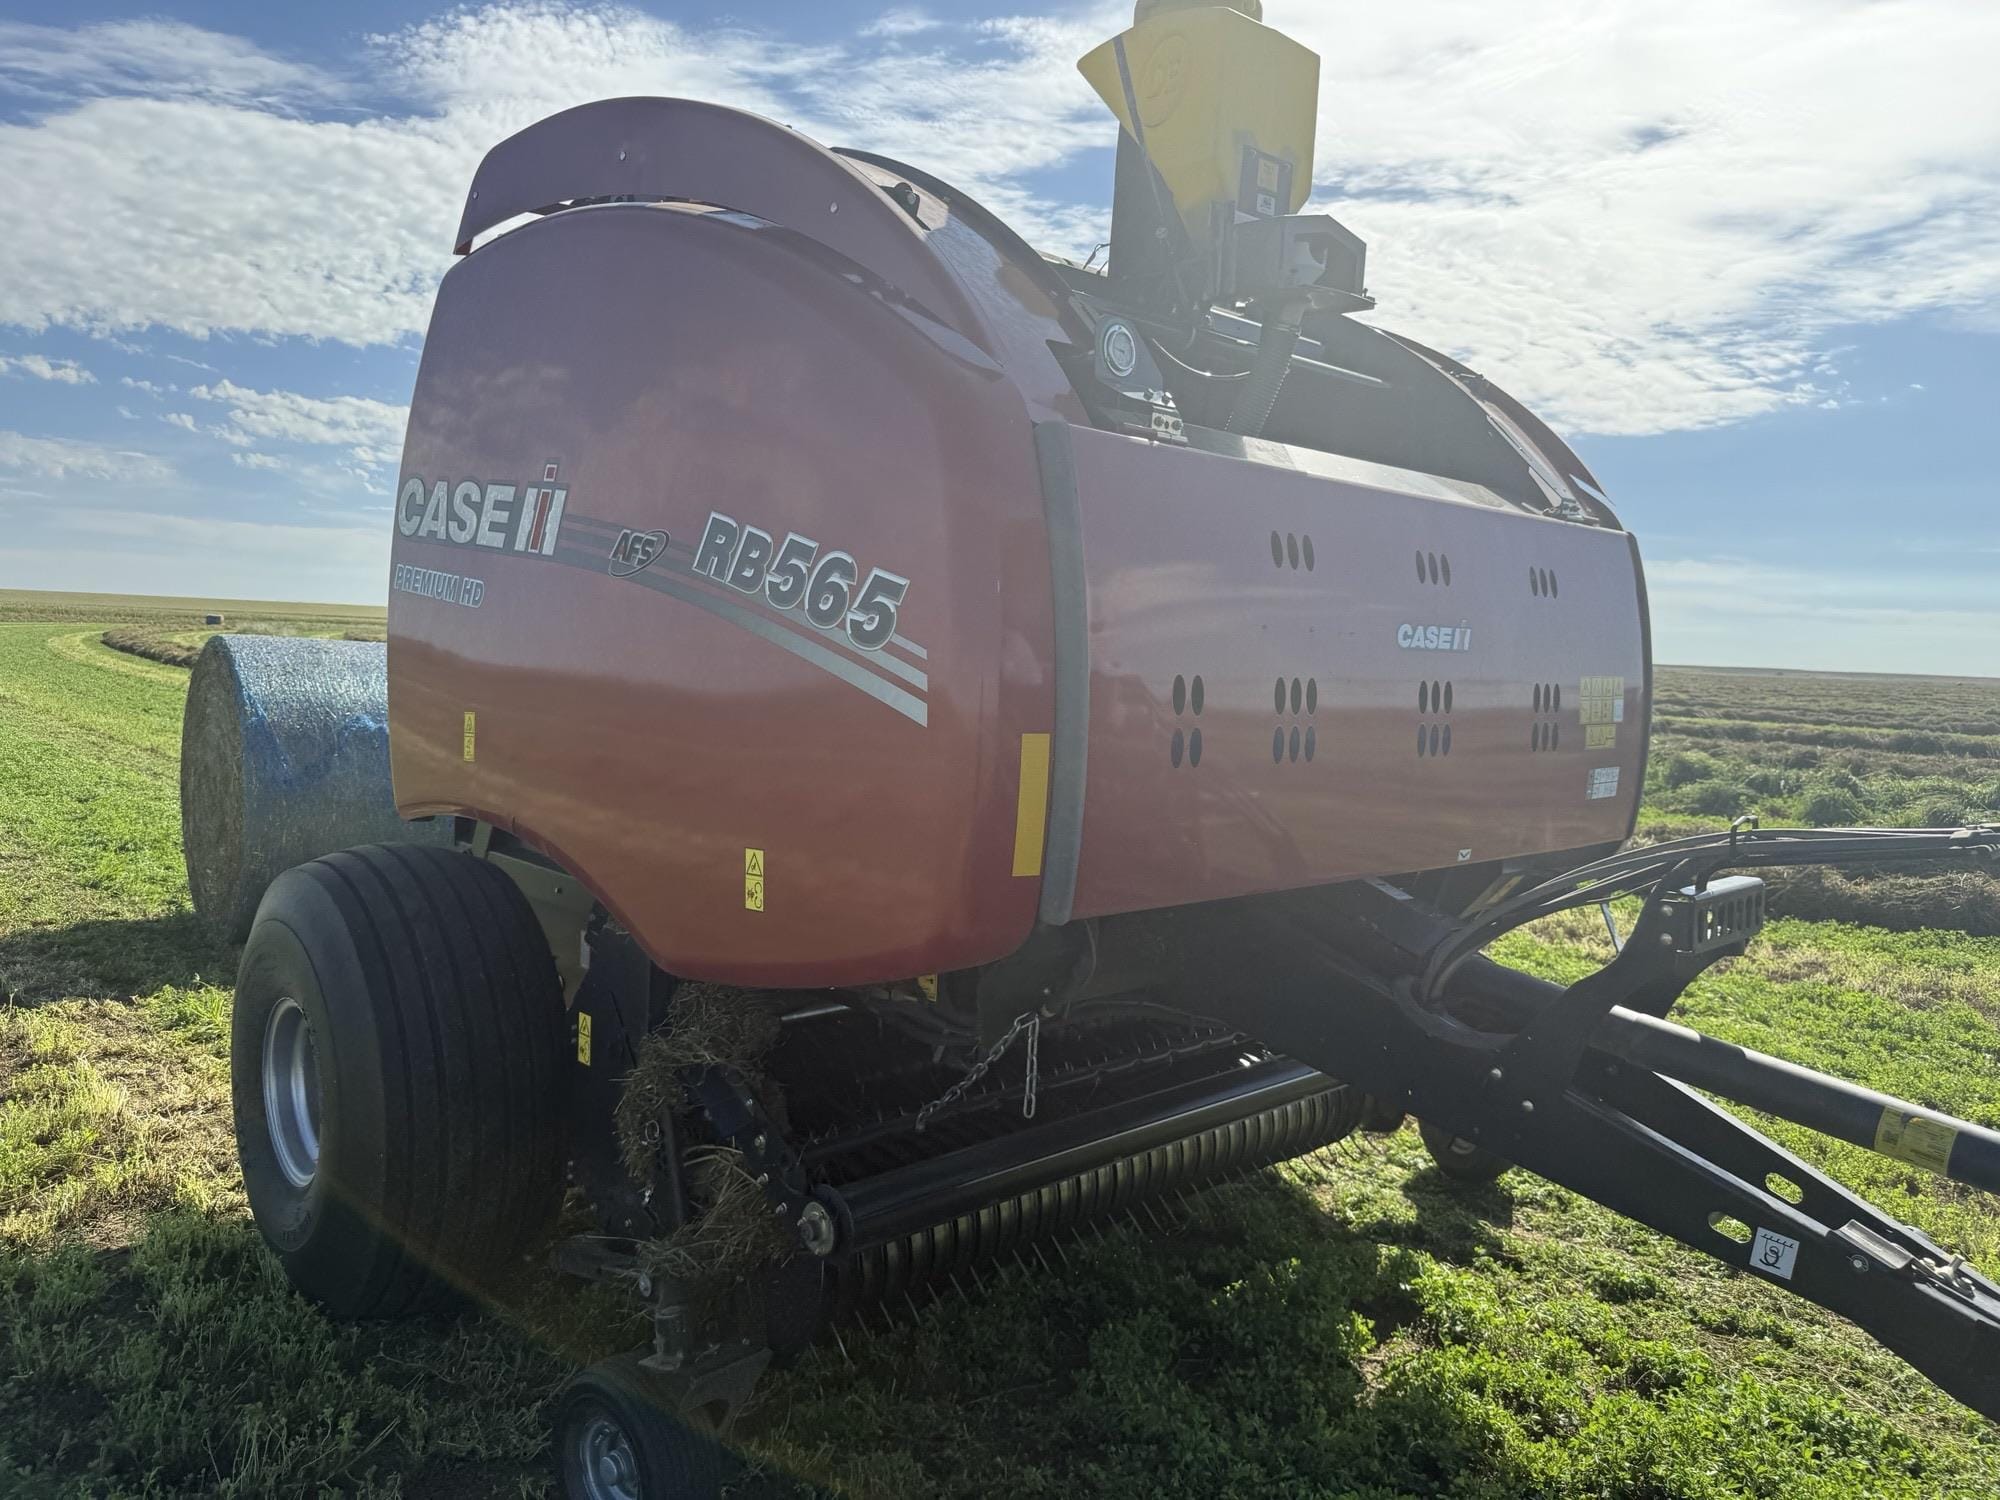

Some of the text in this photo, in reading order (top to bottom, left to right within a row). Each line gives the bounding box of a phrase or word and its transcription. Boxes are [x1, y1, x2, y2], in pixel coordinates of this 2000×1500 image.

[399, 479, 515, 547] CASE
[610, 528, 657, 566] AFS
[394, 563, 485, 608] PREMIUM HD
[693, 511, 910, 651] RB565
[1397, 624, 1453, 650] CASE
